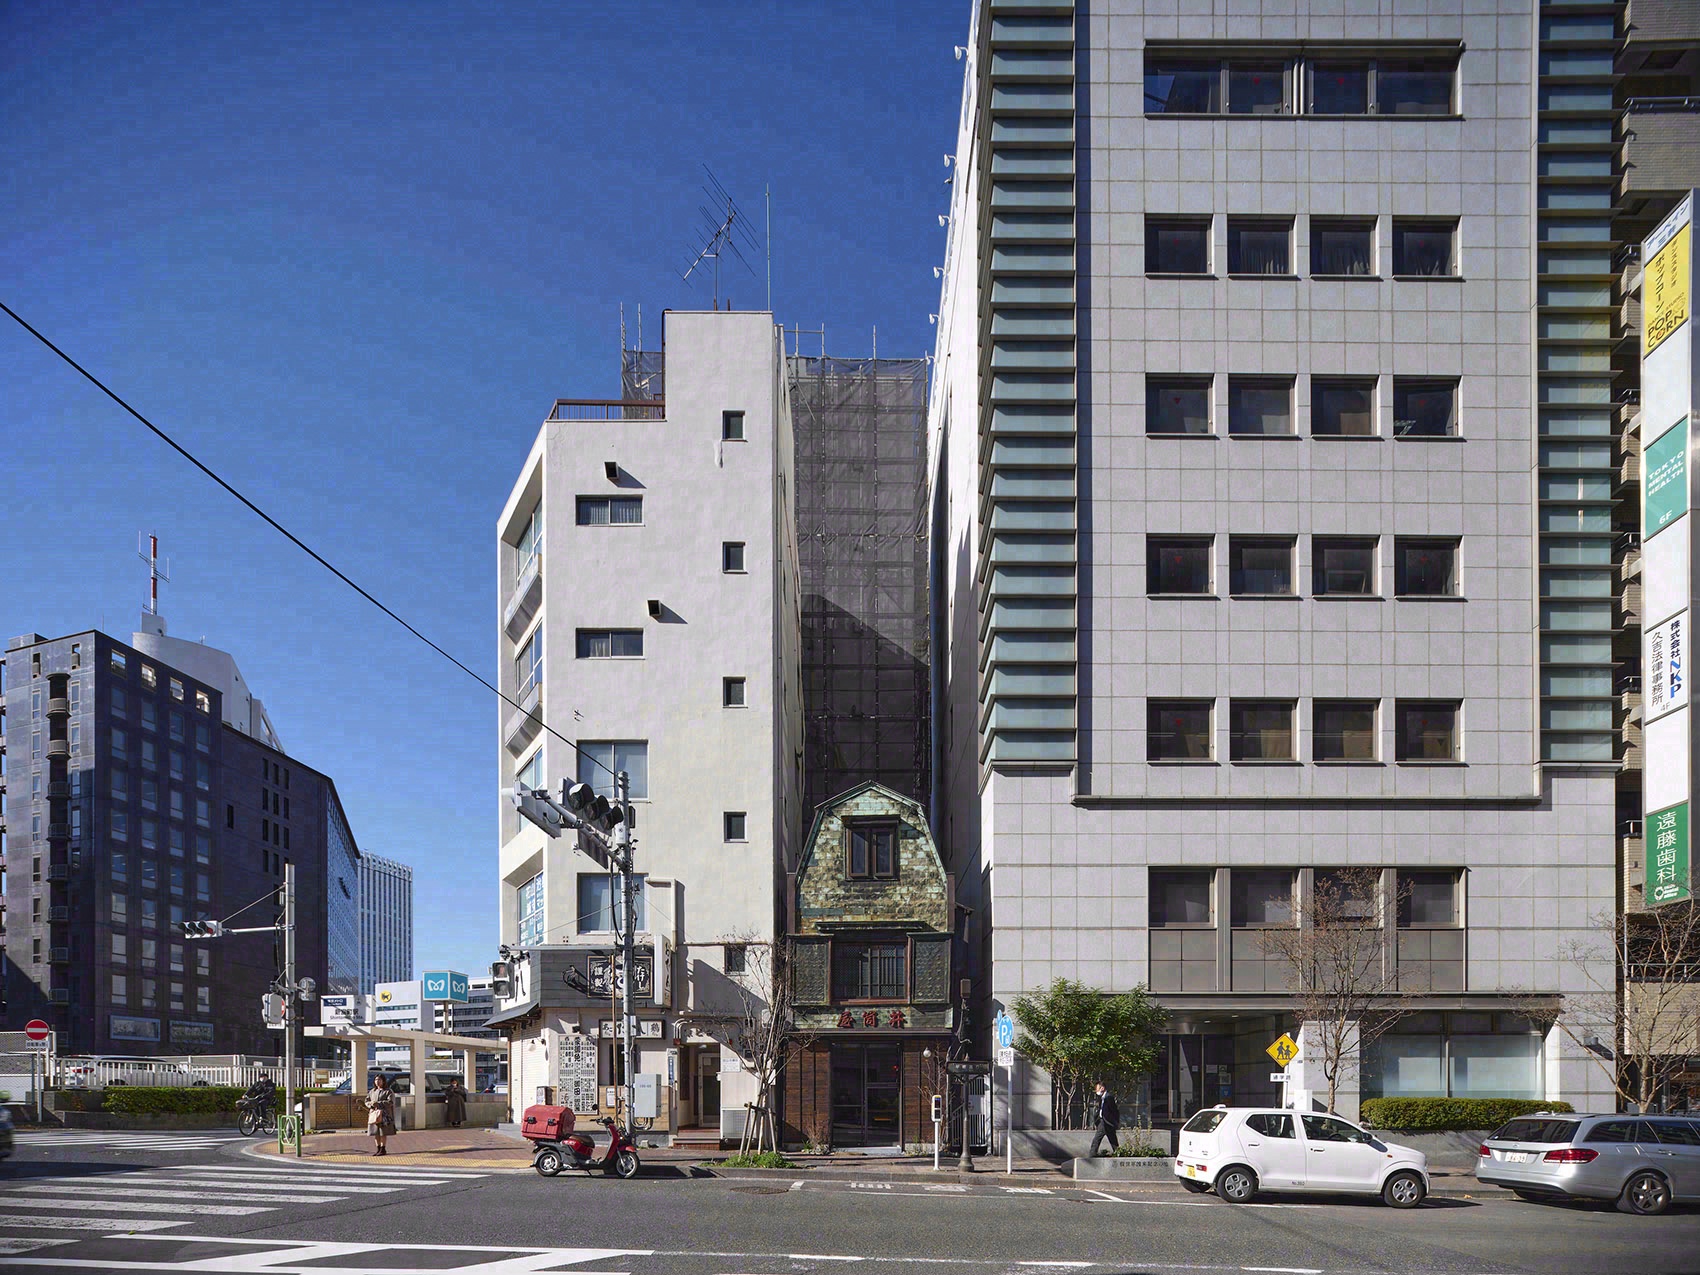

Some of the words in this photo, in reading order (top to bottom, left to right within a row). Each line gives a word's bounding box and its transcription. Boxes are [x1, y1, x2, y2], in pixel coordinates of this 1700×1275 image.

[1647, 203, 1688, 249] アーベイン
[1655, 254, 1665, 313] ポップコーン
[1648, 310, 1672, 339] POP
[1648, 309, 1684, 348] CORN
[1648, 450, 1684, 480] TOKYO
[1648, 460, 1684, 489] MENTAL
[1648, 467, 1684, 497] HEALTH
[1659, 511, 1672, 525] 6F
[1656, 811, 1677, 884] 遠藤歯科
[1001, 1024, 1009, 1045] P
